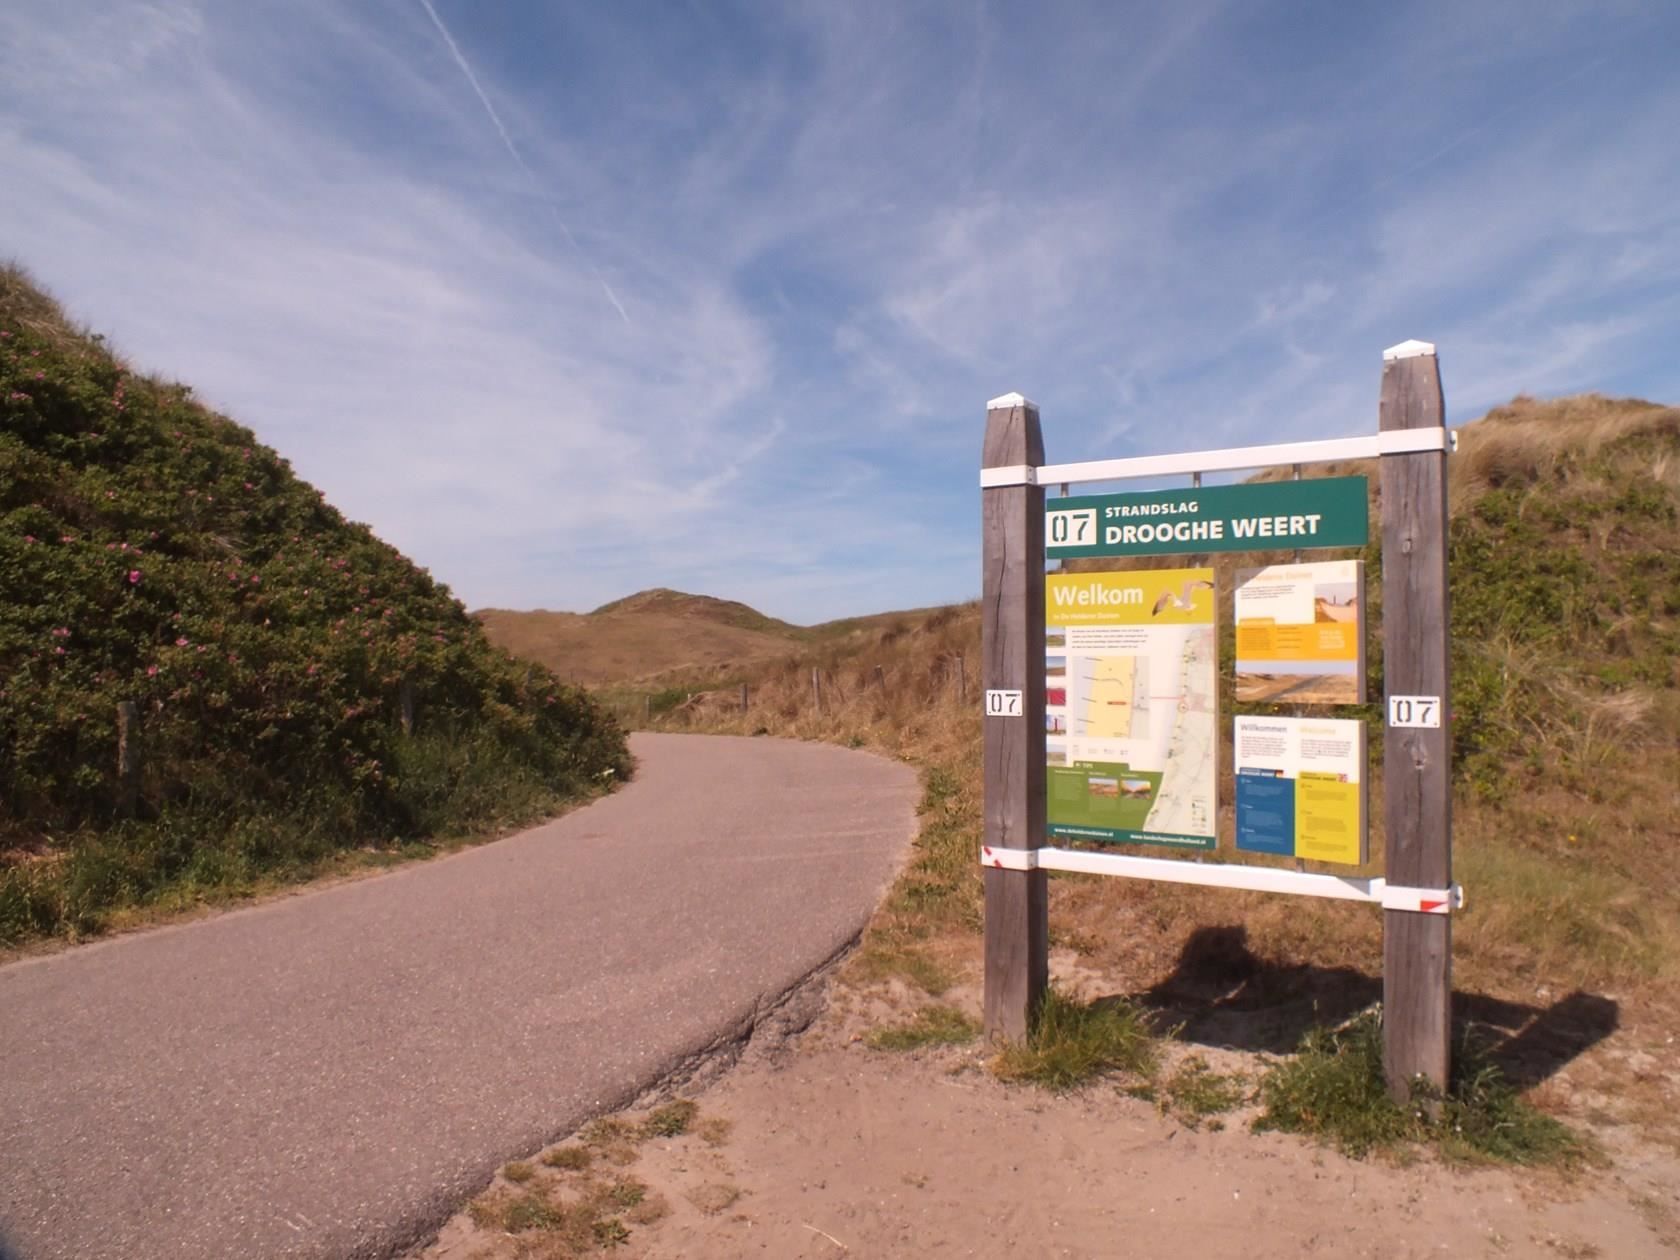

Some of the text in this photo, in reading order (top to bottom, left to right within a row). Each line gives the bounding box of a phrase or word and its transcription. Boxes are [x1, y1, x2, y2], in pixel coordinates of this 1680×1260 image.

[1105, 501, 1199, 518] STRANDSLAG
[1052, 513, 1091, 542] 07
[1105, 514, 1321, 545] DROOGHE WEERT
[1053, 583, 1144, 606] Welkom
[991, 693, 1018, 713] 07
[1396, 700, 1433, 724] 07
